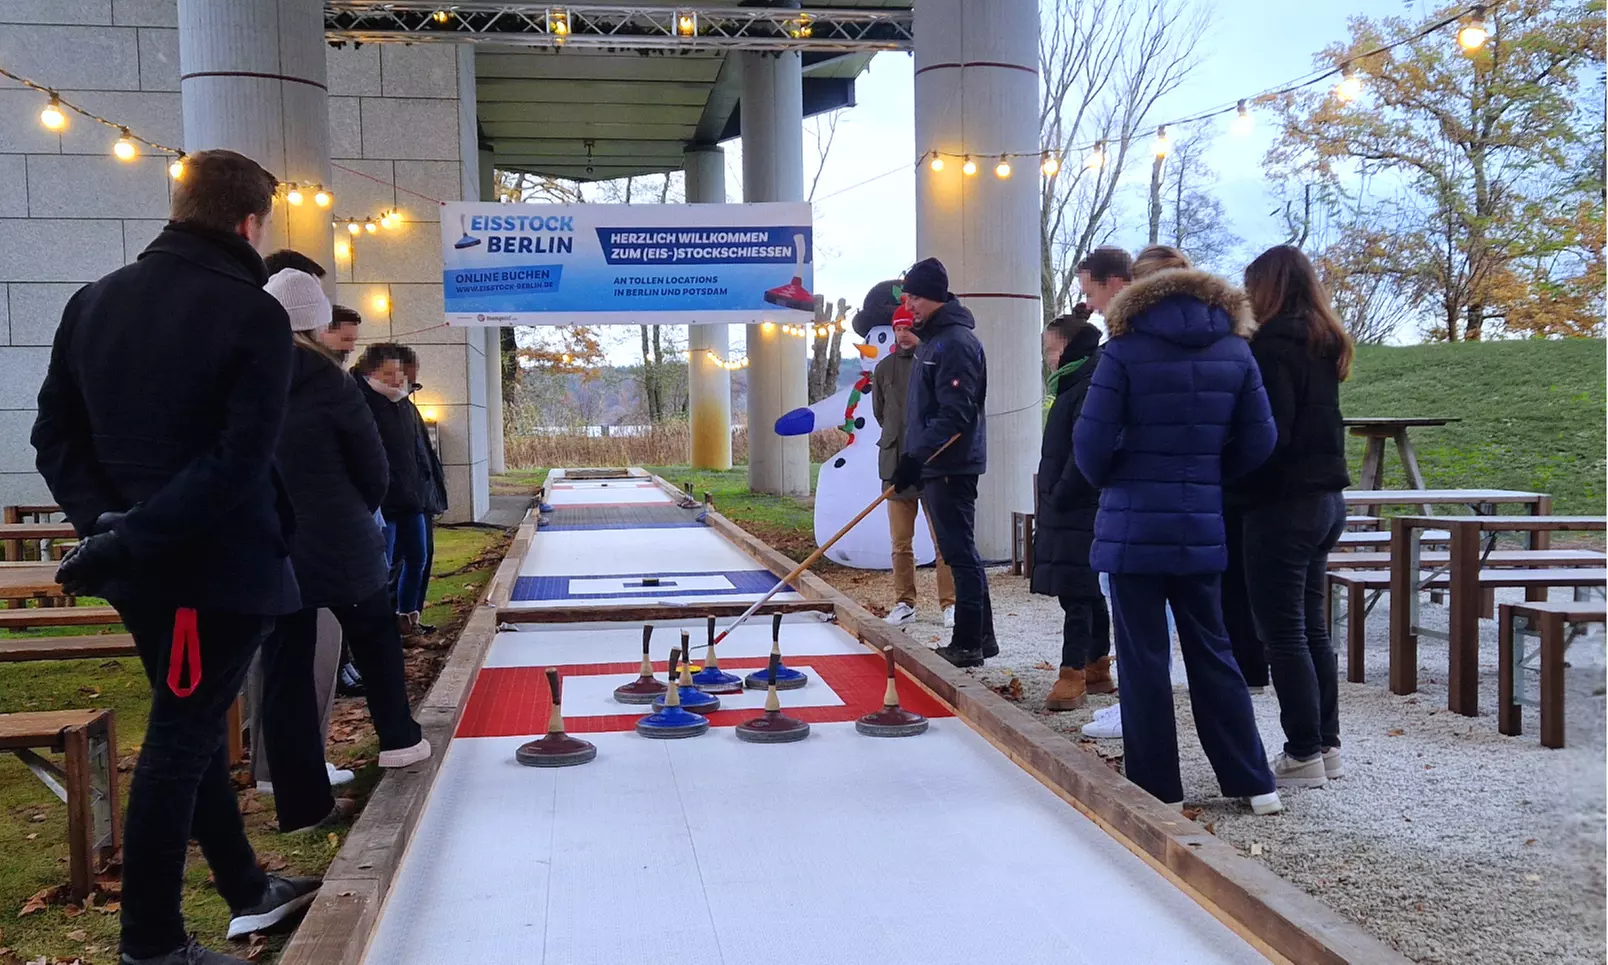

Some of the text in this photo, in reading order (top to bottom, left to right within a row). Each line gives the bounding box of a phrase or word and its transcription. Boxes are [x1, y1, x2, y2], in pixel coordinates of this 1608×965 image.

[471, 215, 574, 232] EISSTOCK
[610, 231, 769, 244] HERZLICH WILLKOMMEN
[487, 236, 573, 254] BERLIN
[611, 245, 792, 262] ZUM (EIS-)STOCKSCHIESSEN
[455, 269, 550, 284] ONLINE BUCHEN
[614, 276, 718, 285] AN TOLLEN LOCATIONS
[455, 281, 553, 293] WWW.EISSTOCK-BERLIN.DE
[614, 287, 728, 297] IN BERLIN UND POTSDAM
